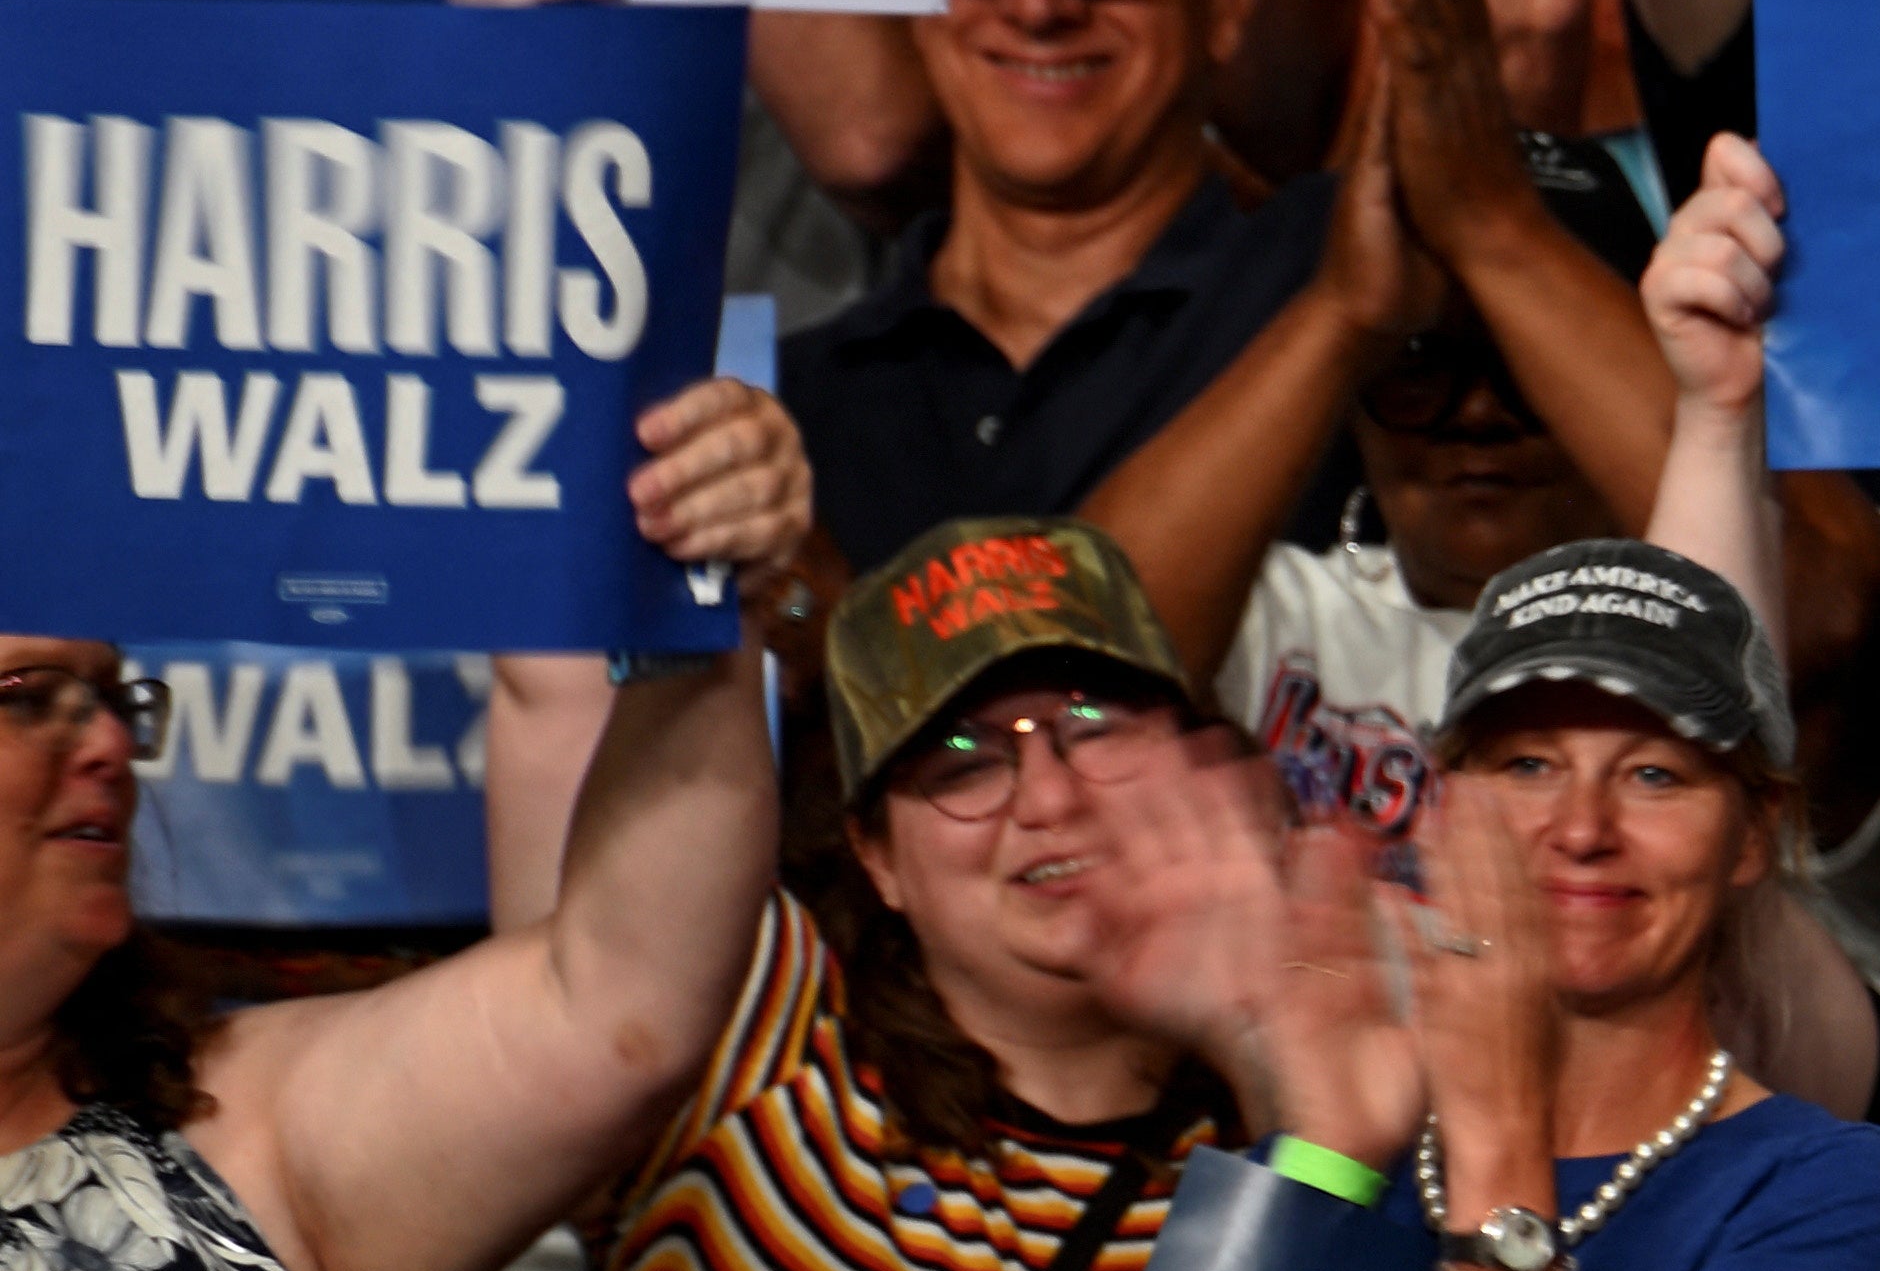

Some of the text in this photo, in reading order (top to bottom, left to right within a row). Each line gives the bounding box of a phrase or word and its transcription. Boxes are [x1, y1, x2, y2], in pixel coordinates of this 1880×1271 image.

[21, 112, 653, 361] HARRIS
[115, 370, 566, 509] WALZ
[892, 534, 1067, 626] HARRIS
[928, 580, 1059, 640] WALZ
[1568, 564, 1708, 614] AMERICA
[1579, 592, 1680, 629] AGAIN
